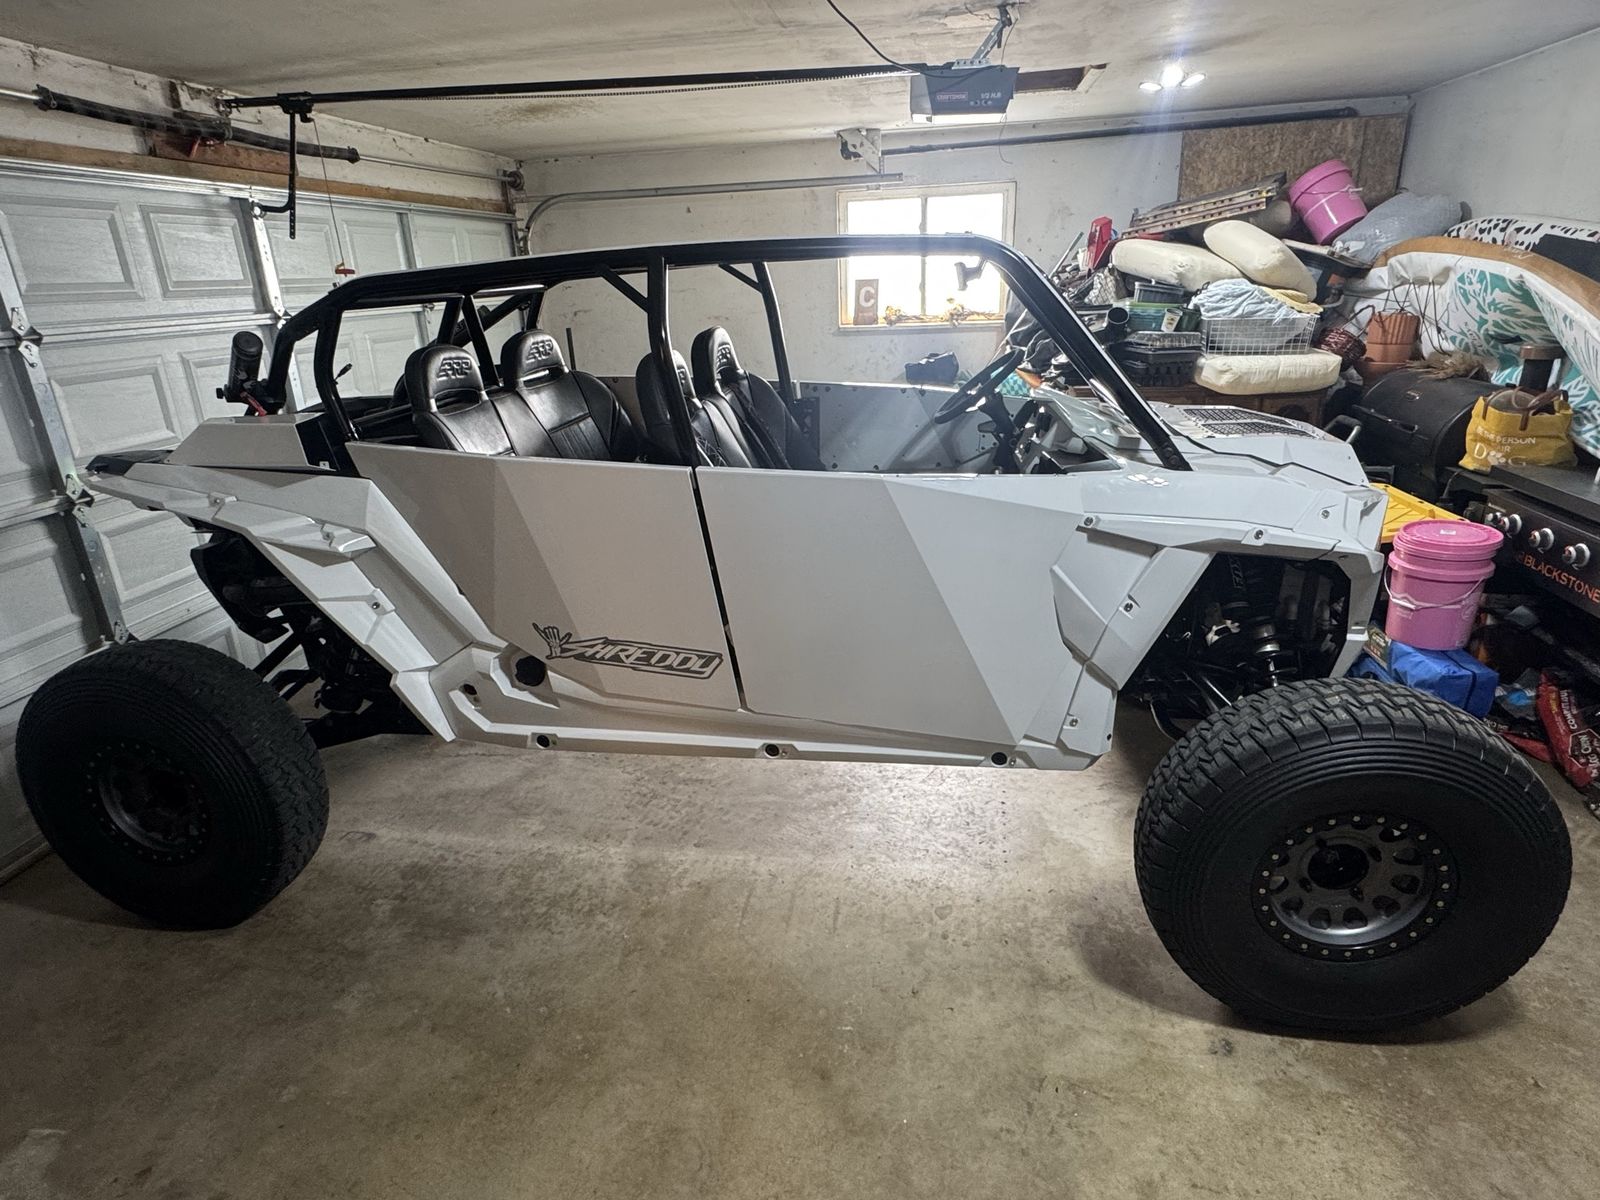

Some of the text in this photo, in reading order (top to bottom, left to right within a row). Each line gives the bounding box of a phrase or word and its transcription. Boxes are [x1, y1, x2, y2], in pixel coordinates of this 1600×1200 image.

[859, 286, 875, 307] C
[1496, 436, 1536, 445] PERSON
[1523, 555, 1600, 604] BLACKSTONE
